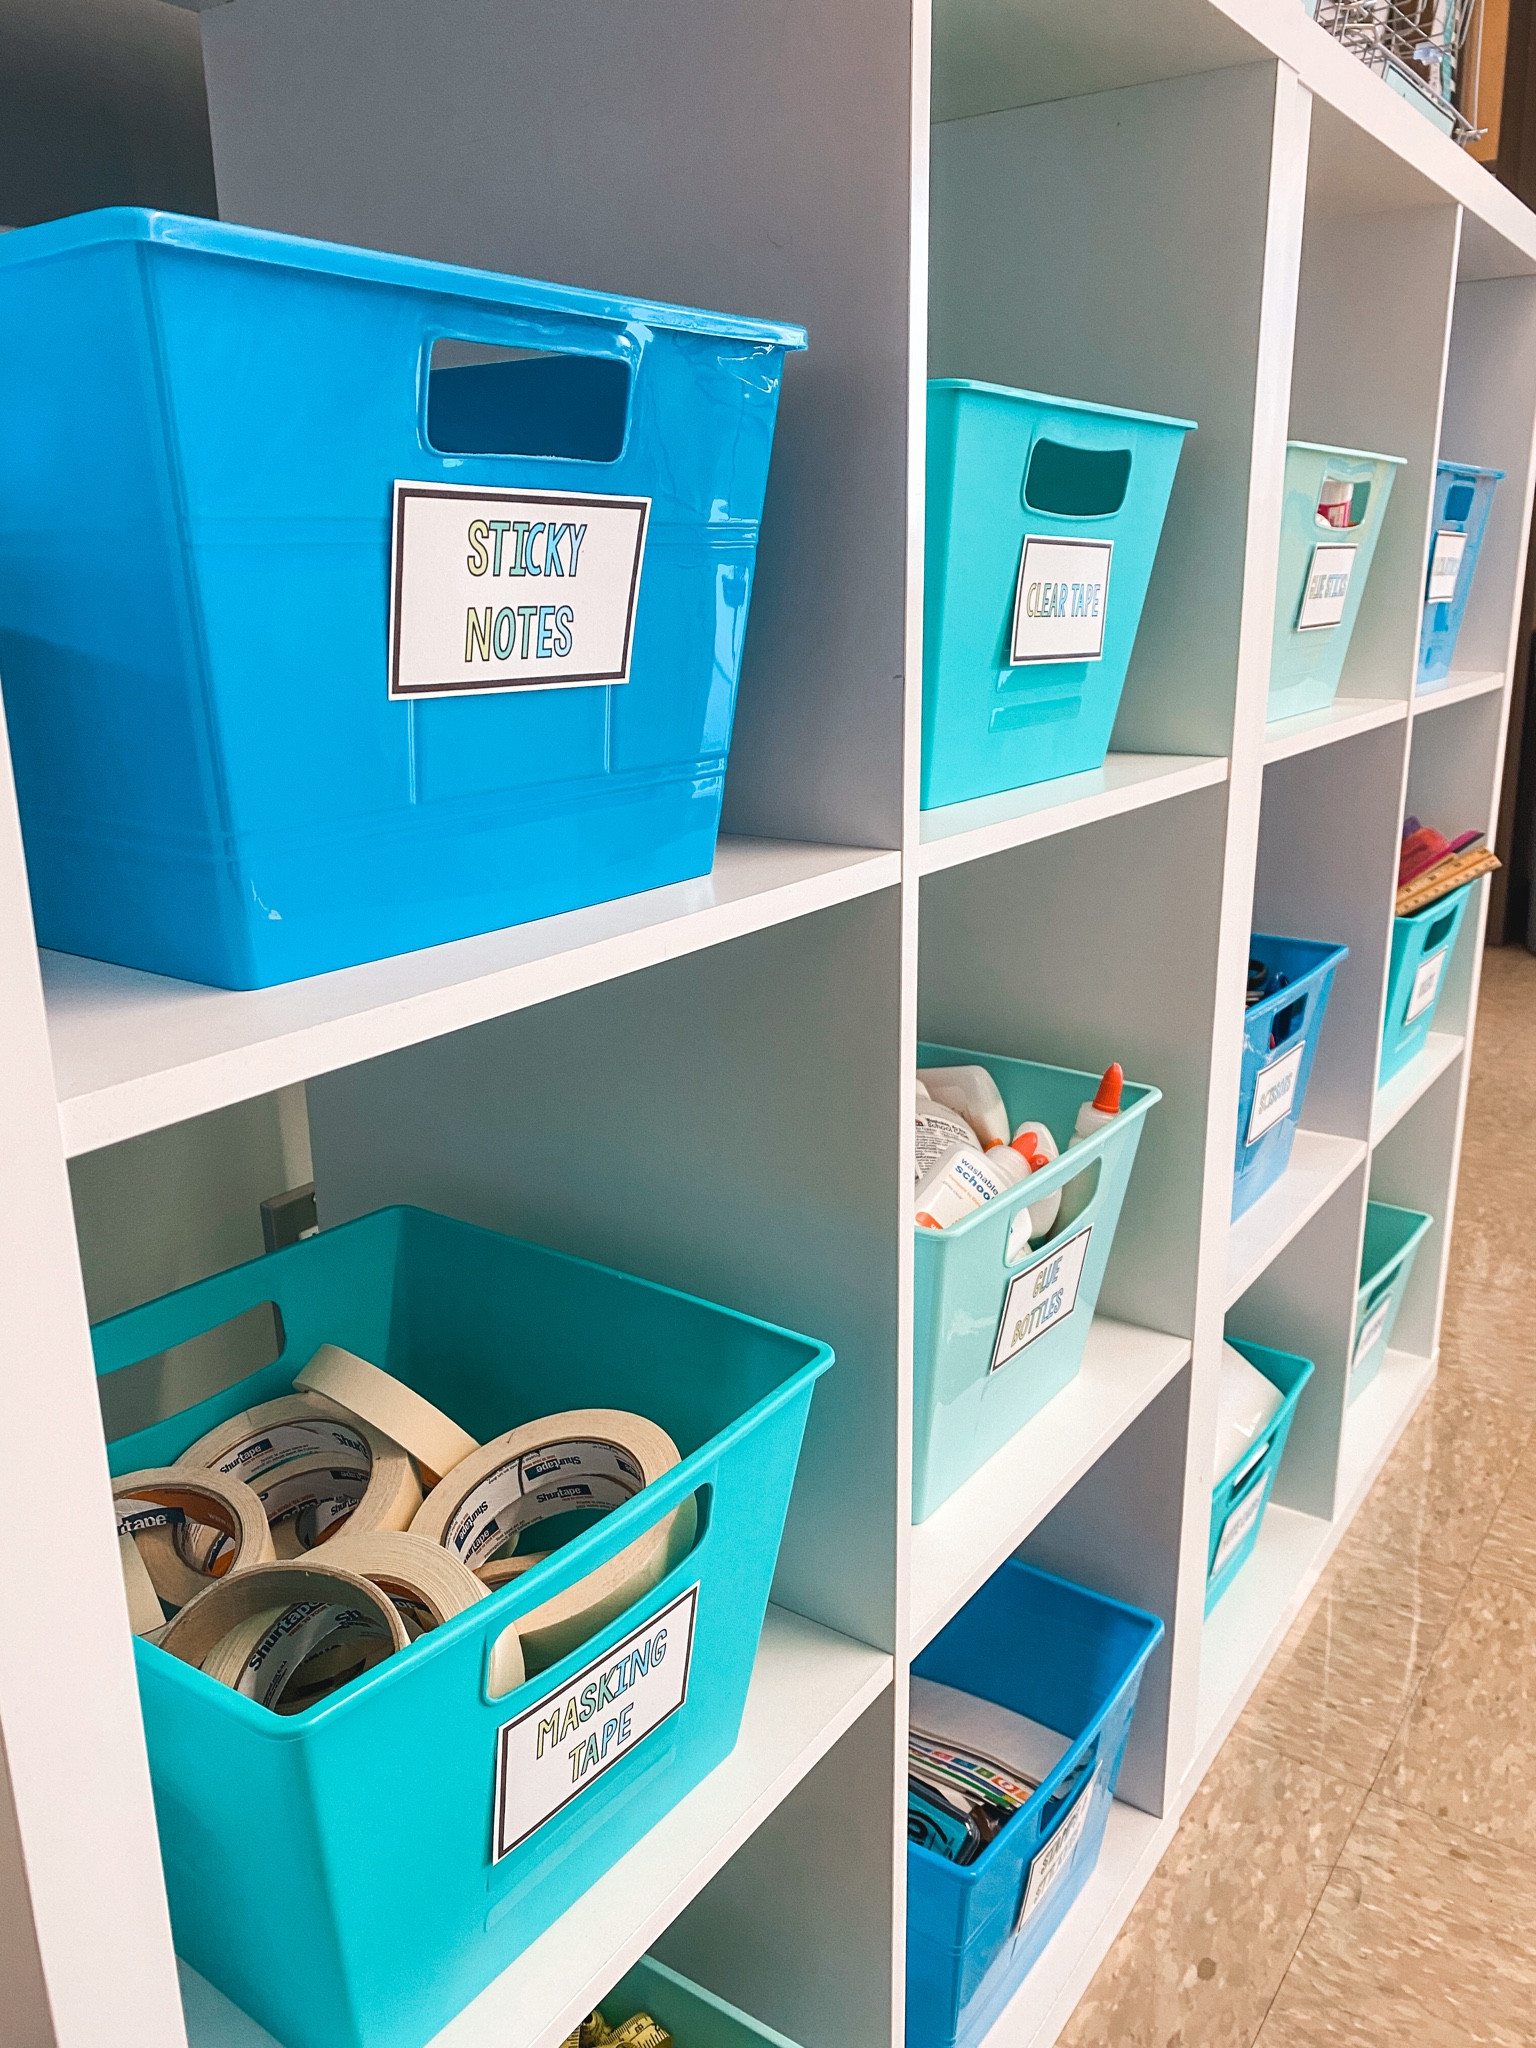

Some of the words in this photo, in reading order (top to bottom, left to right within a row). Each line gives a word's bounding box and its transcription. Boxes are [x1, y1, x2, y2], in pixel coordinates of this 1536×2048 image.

[467, 519, 588, 577] STICKY
[1027, 582, 1068, 617] CLEAR
[1071, 583, 1100, 617] TAPE
[465, 605, 574, 662] NOTES
[955, 1164, 996, 1201] schoo
[961, 1157, 999, 1196] washable
[1032, 1255, 1063, 1298] GLUE
[1011, 1287, 1063, 1348] BOTTLES
[536, 1456, 582, 1474] Shurtape
[537, 1486, 582, 1504] Shurtape
[117, 1514, 168, 1537] rtape
[458, 1500, 488, 1541] Shurtape
[536, 1628, 668, 1760] MASKING
[568, 1702, 634, 1783] TAPE
